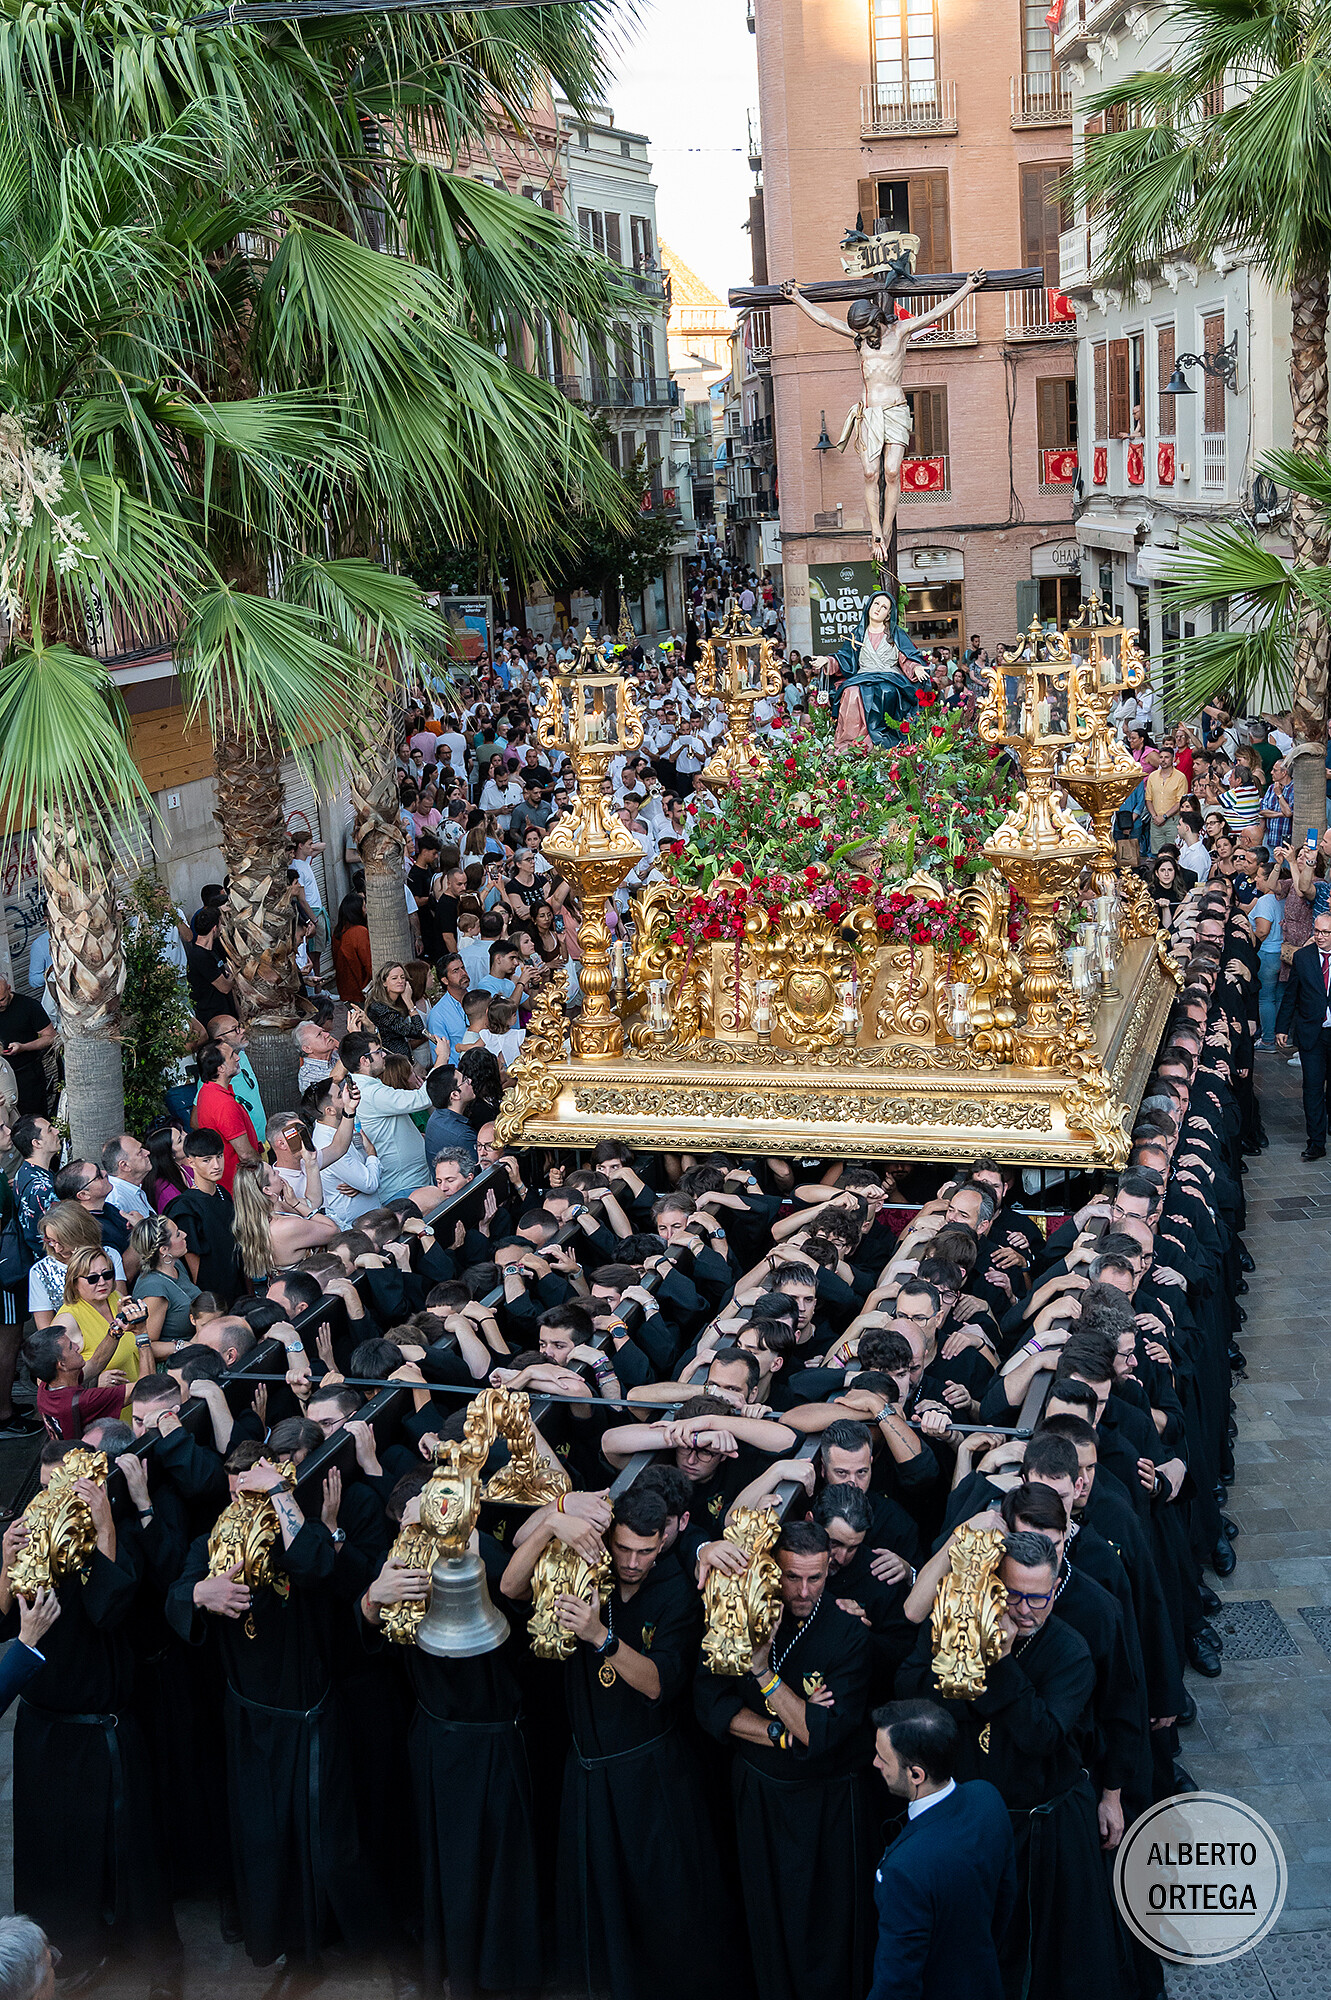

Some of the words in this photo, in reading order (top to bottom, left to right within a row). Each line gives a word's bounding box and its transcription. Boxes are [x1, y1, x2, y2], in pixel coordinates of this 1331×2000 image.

[1052, 549, 1080, 563] OHAN
[837, 587, 858, 595] The
[819, 611, 863, 623] WOR
[837, 623, 858, 634] he
